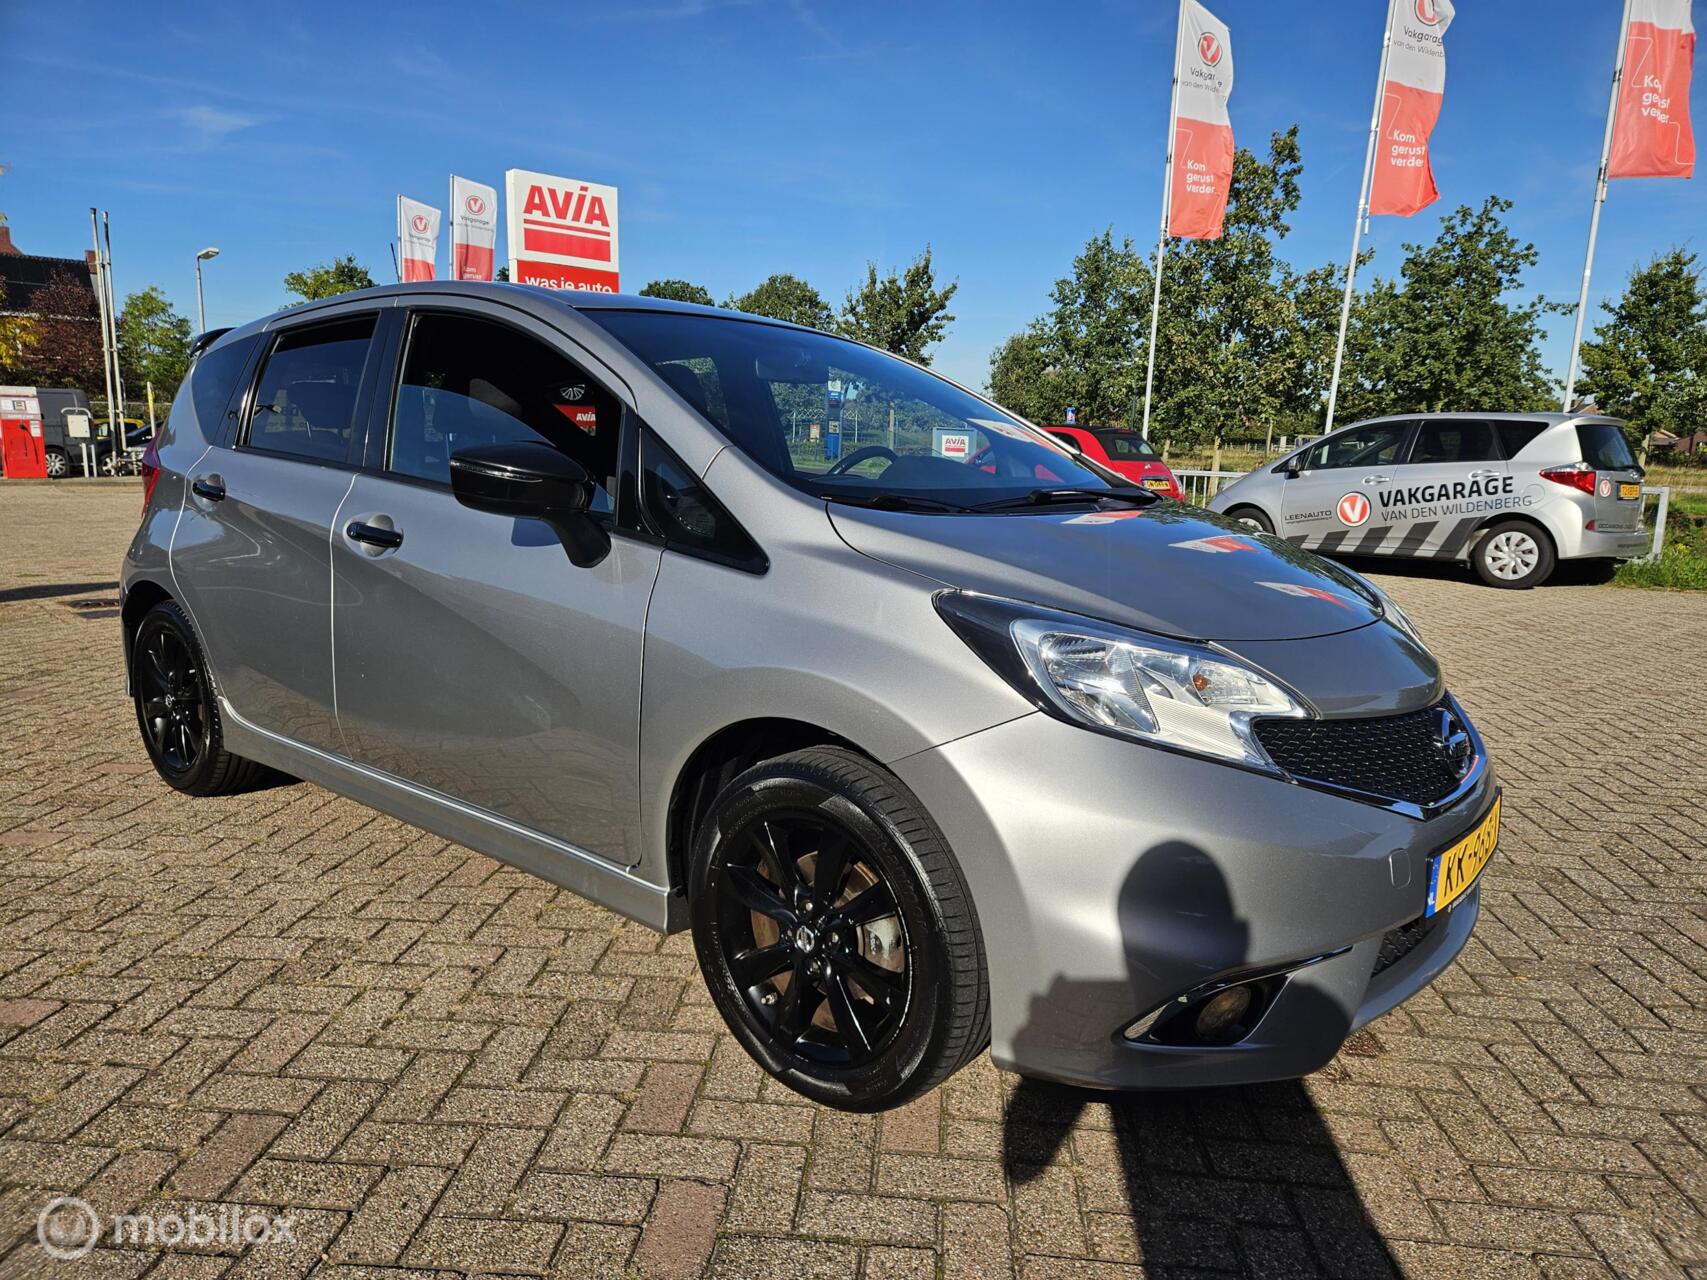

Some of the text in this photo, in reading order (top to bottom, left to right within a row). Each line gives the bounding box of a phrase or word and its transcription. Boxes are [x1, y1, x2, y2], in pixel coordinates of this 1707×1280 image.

[1404, 25, 1443, 47] Vakgarag
[1393, 128, 1416, 143] Kom
[1391, 144, 1426, 157] gerust
[1187, 159, 1206, 172] Kom
[1391, 156, 1425, 168] verde
[1186, 172, 1215, 184] gerust
[1186, 183, 1217, 194] verder
[525, 276, 558, 290] was
[578, 281, 613, 294] auto
[1379, 476, 1514, 508] VAKGARAGE
[1284, 509, 1332, 521] LEENAUTO
[1381, 495, 1533, 522] VAN DEN WILDENBERG
